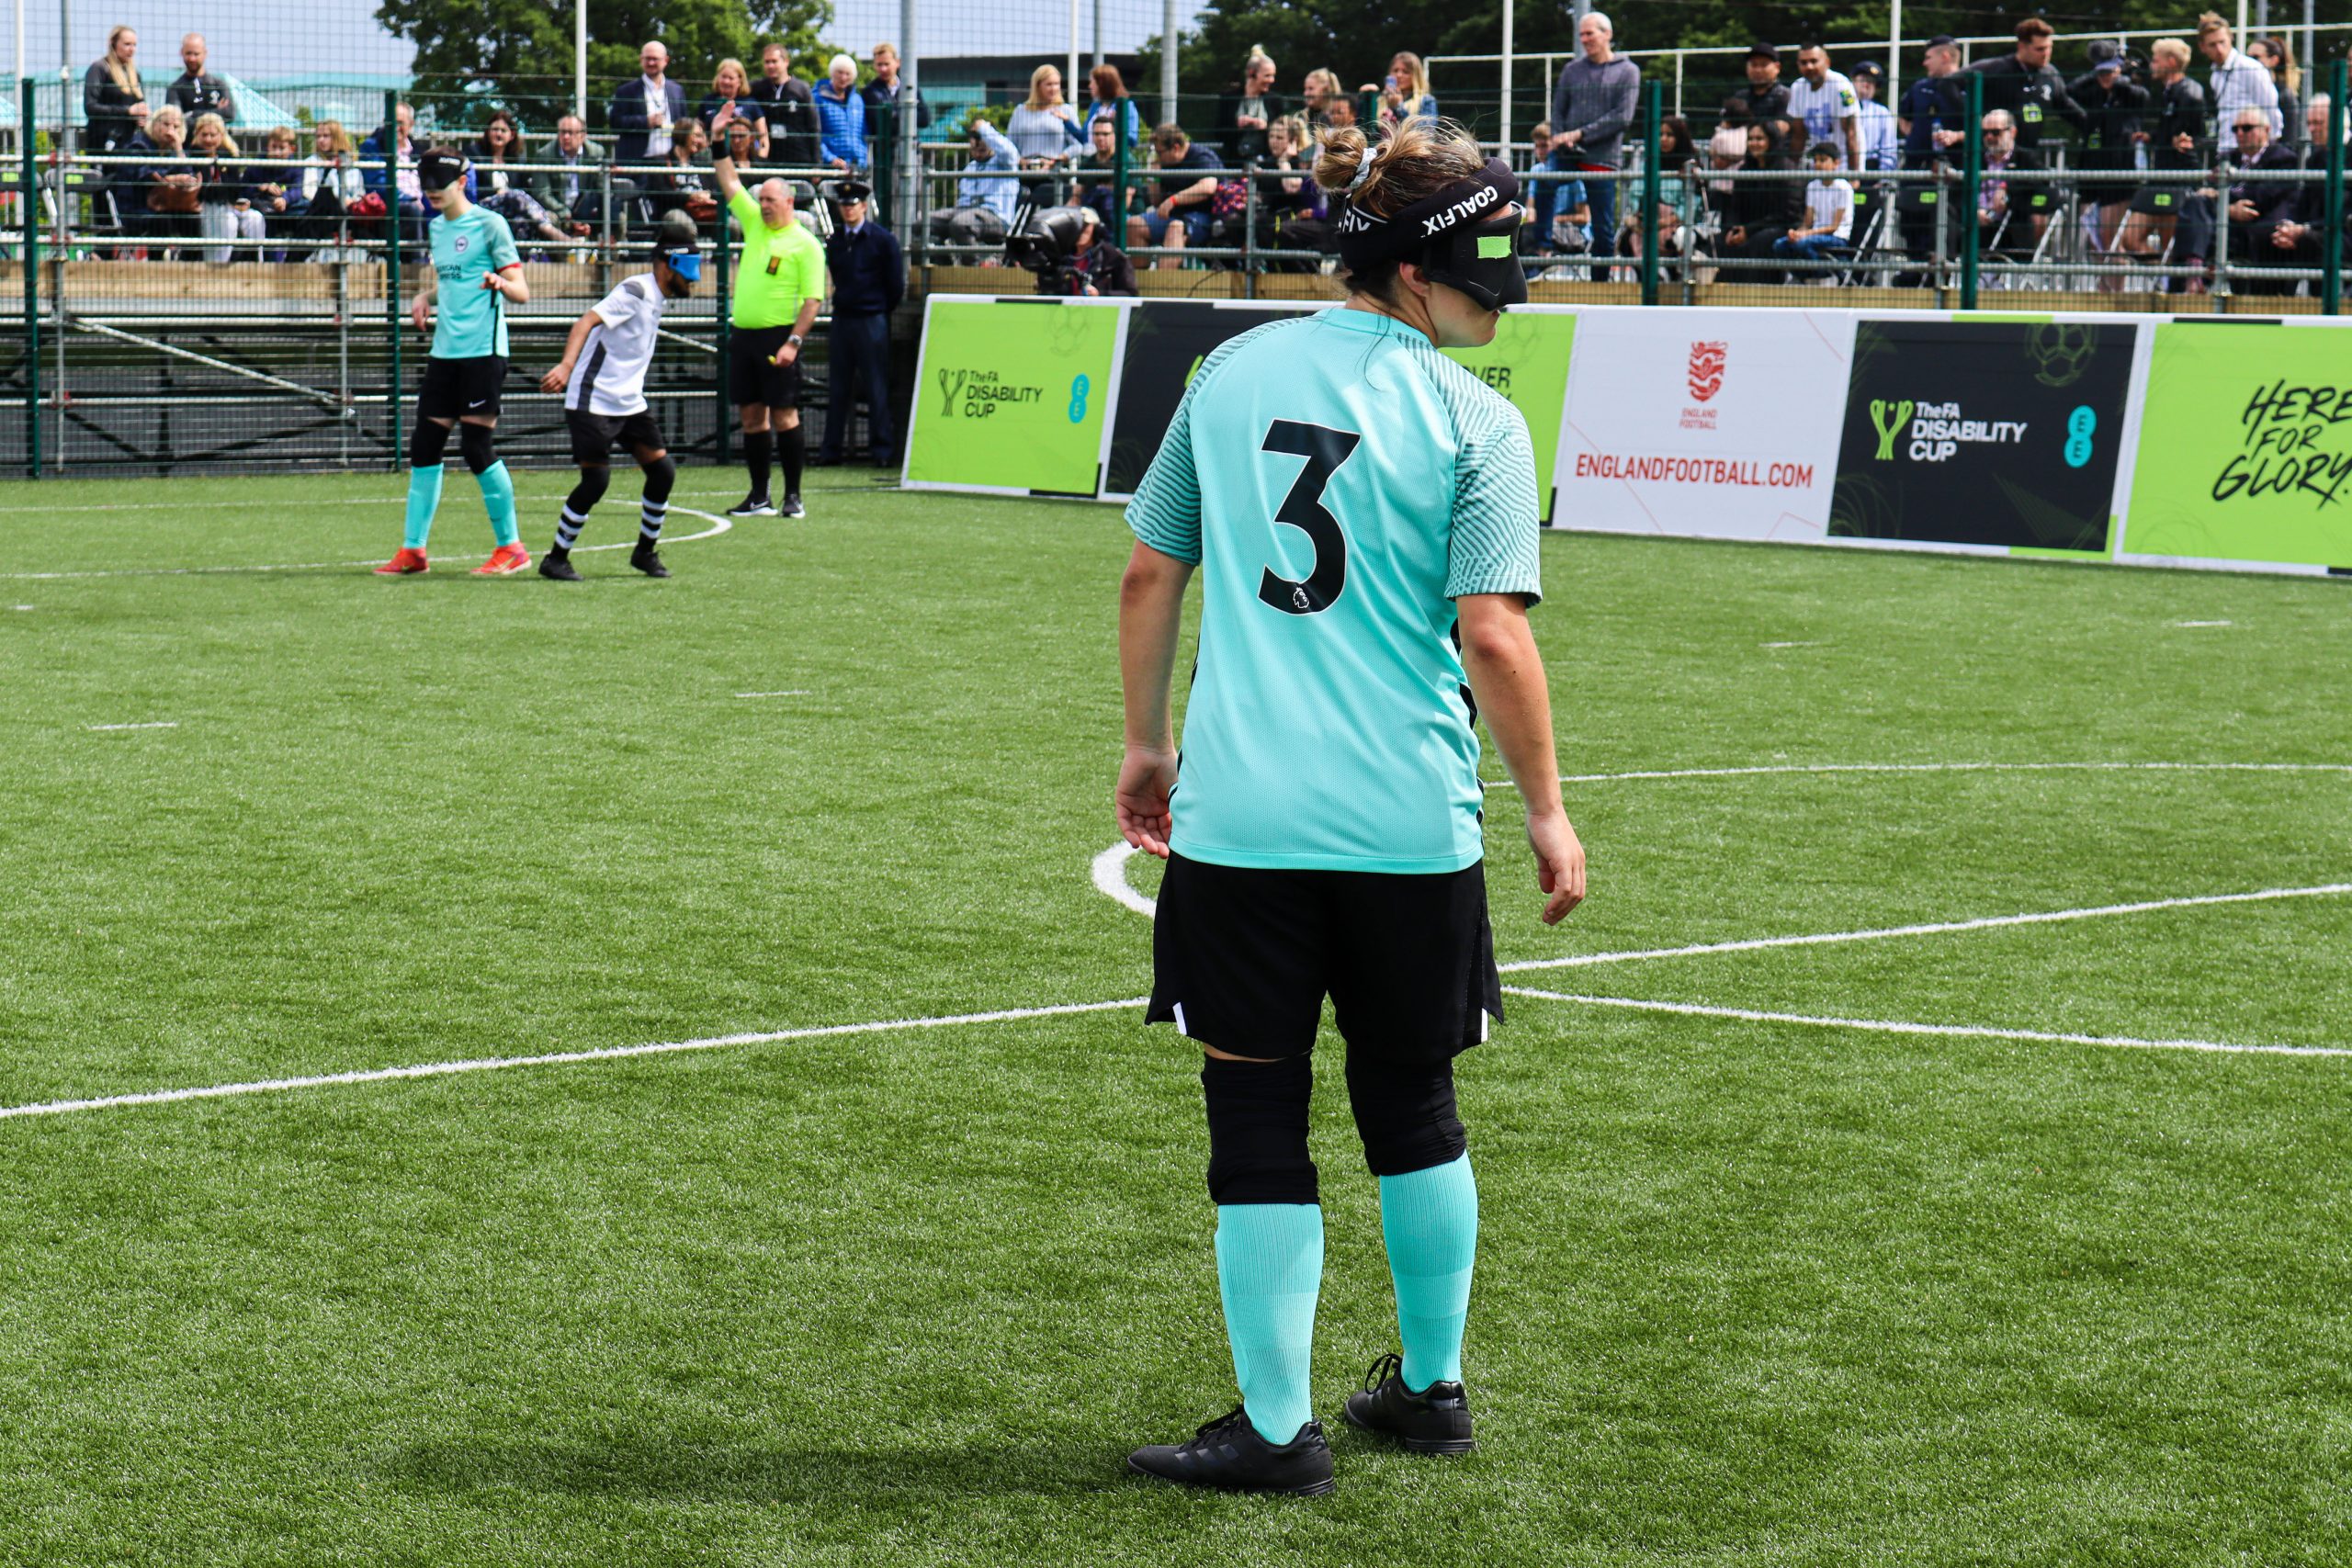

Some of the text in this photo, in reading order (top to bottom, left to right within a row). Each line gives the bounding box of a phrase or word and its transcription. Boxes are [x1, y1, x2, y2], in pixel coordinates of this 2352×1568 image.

[1422, 186, 1498, 236] GOALFIX
[1463, 366, 1511, 388] VER
[967, 385, 1044, 402] DISABILITY
[965, 402, 996, 417] CUP
[1681, 407, 1718, 419] ENGLAND
[2242, 378, 2352, 446] HERE
[1679, 419, 1717, 430] FOOTBALL
[1911, 419, 2028, 443] DISABILITY
[1908, 441, 1957, 461] CUP
[2249, 424, 2324, 465] FOR
[1576, 454, 1814, 488] ENGLANDFOOTBALL.COM
[1258, 418, 1362, 615] 3
